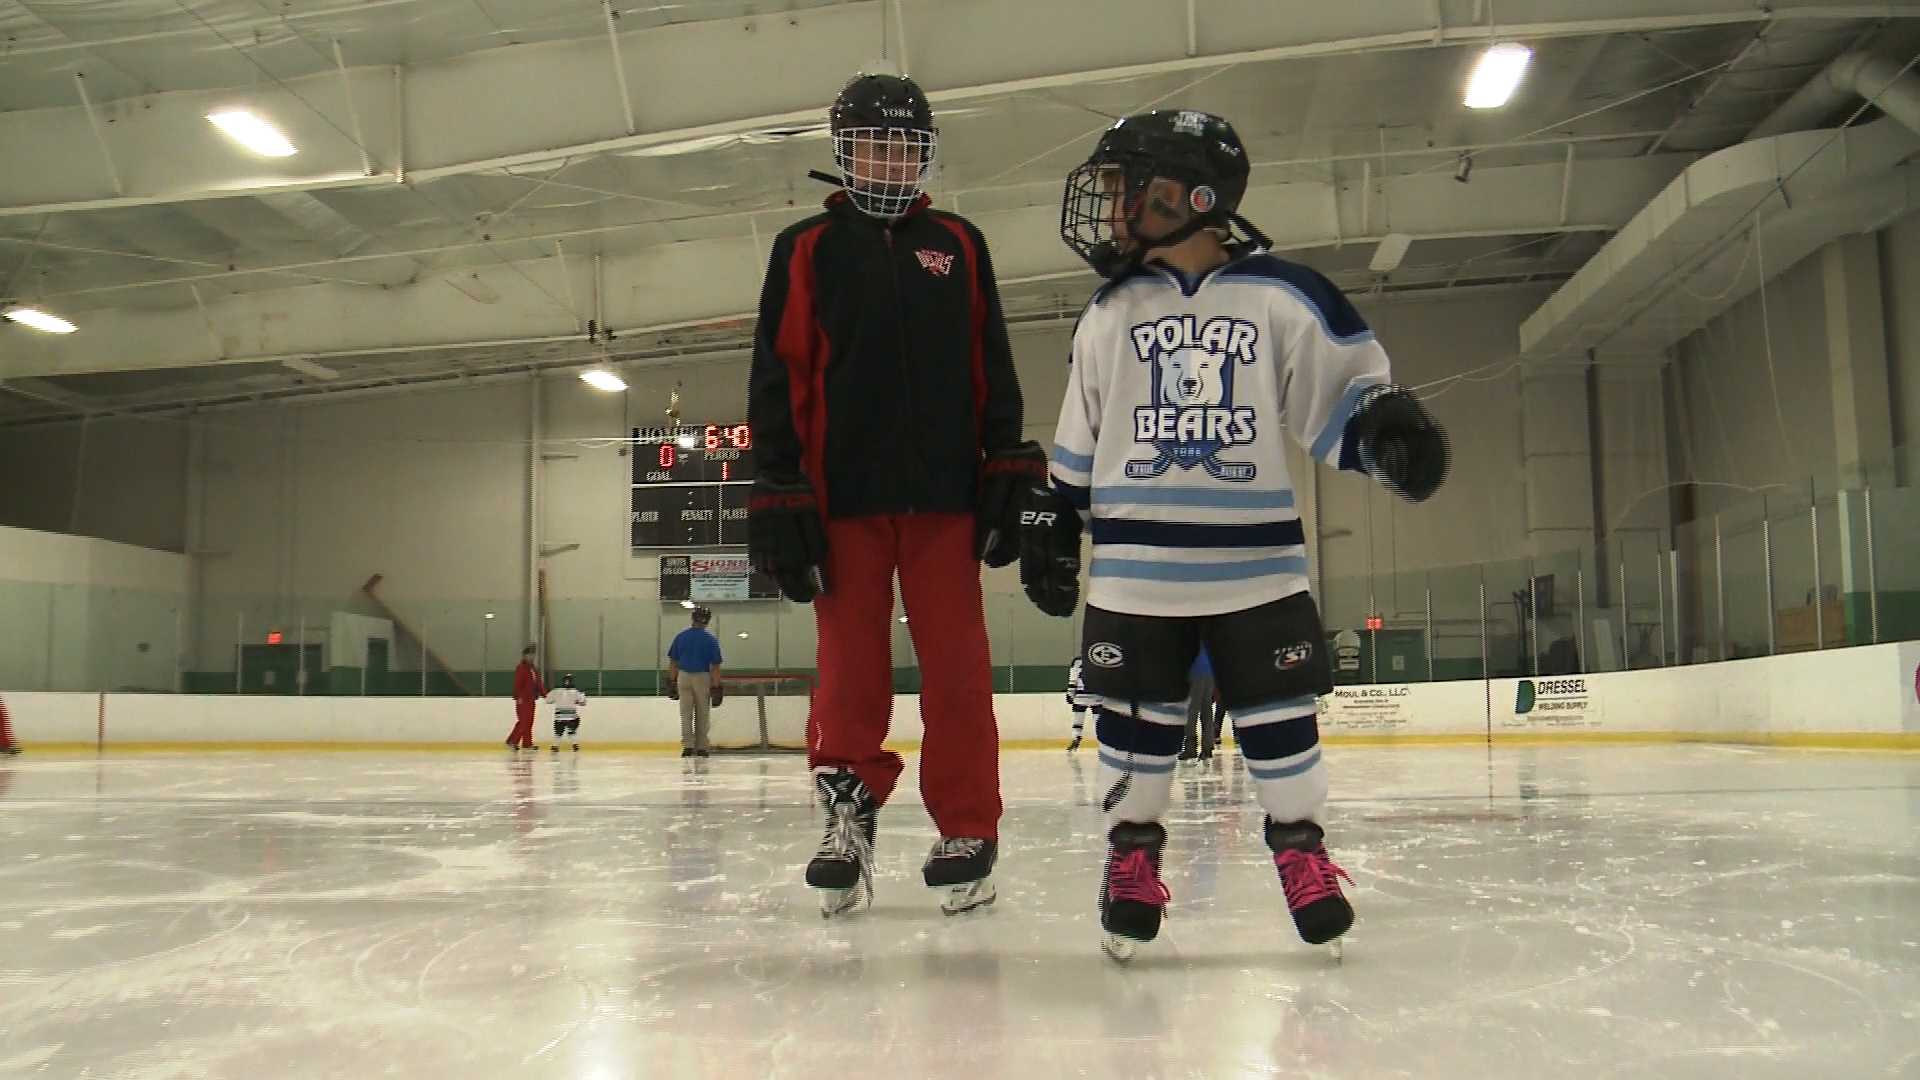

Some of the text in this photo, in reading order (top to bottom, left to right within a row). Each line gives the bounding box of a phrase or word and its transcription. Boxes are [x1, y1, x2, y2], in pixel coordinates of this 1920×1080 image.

[881, 108, 914, 119] YORK
[1131, 314, 1258, 365] POLAR
[1134, 406, 1257, 444] BEARS
[704, 450, 740, 461] PERIOD
[646, 471, 672, 481] GOAL
[631, 509, 713, 523] PLAYER PENALTY
[1537, 679, 1587, 695] DRESSEL
